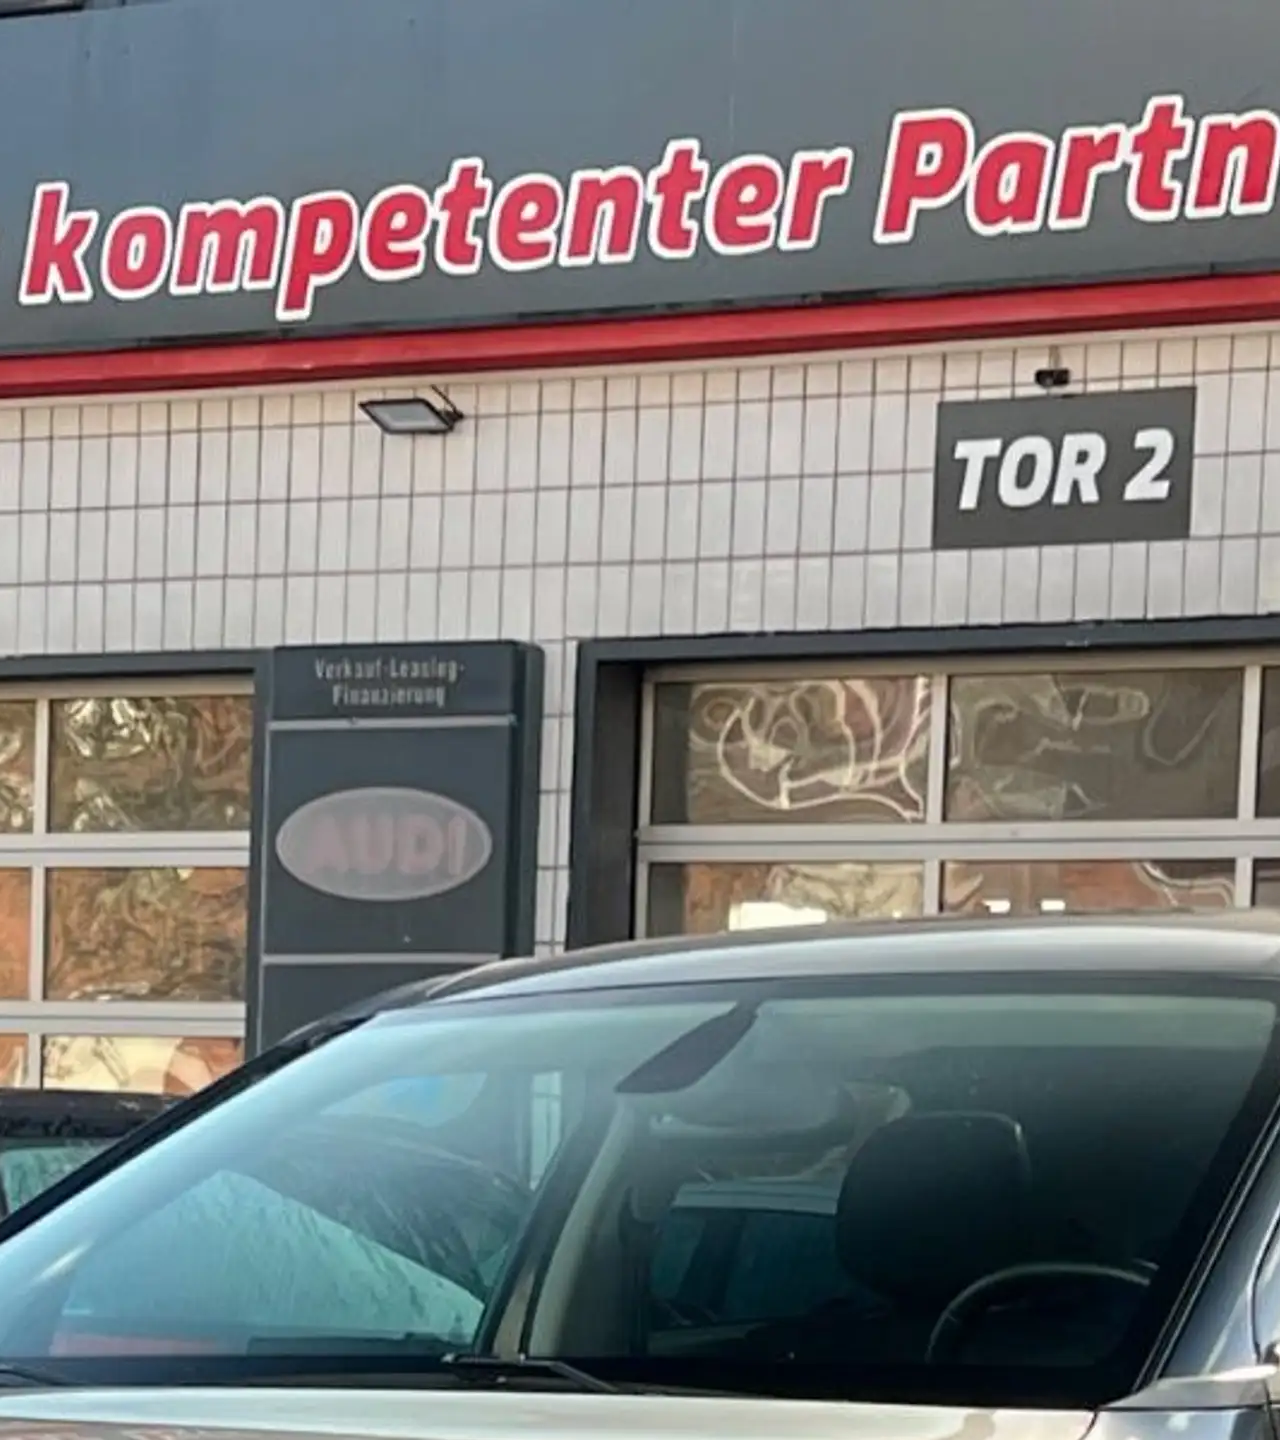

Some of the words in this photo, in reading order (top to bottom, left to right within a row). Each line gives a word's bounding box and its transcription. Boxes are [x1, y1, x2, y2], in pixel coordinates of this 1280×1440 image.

[19, 139, 853, 320] kompetenter
[952, 432, 1106, 510] TOR
[1123, 427, 1175, 502] 2
[332, 684, 446, 708] Finanzierung
[304, 812, 467, 876] AUDI
